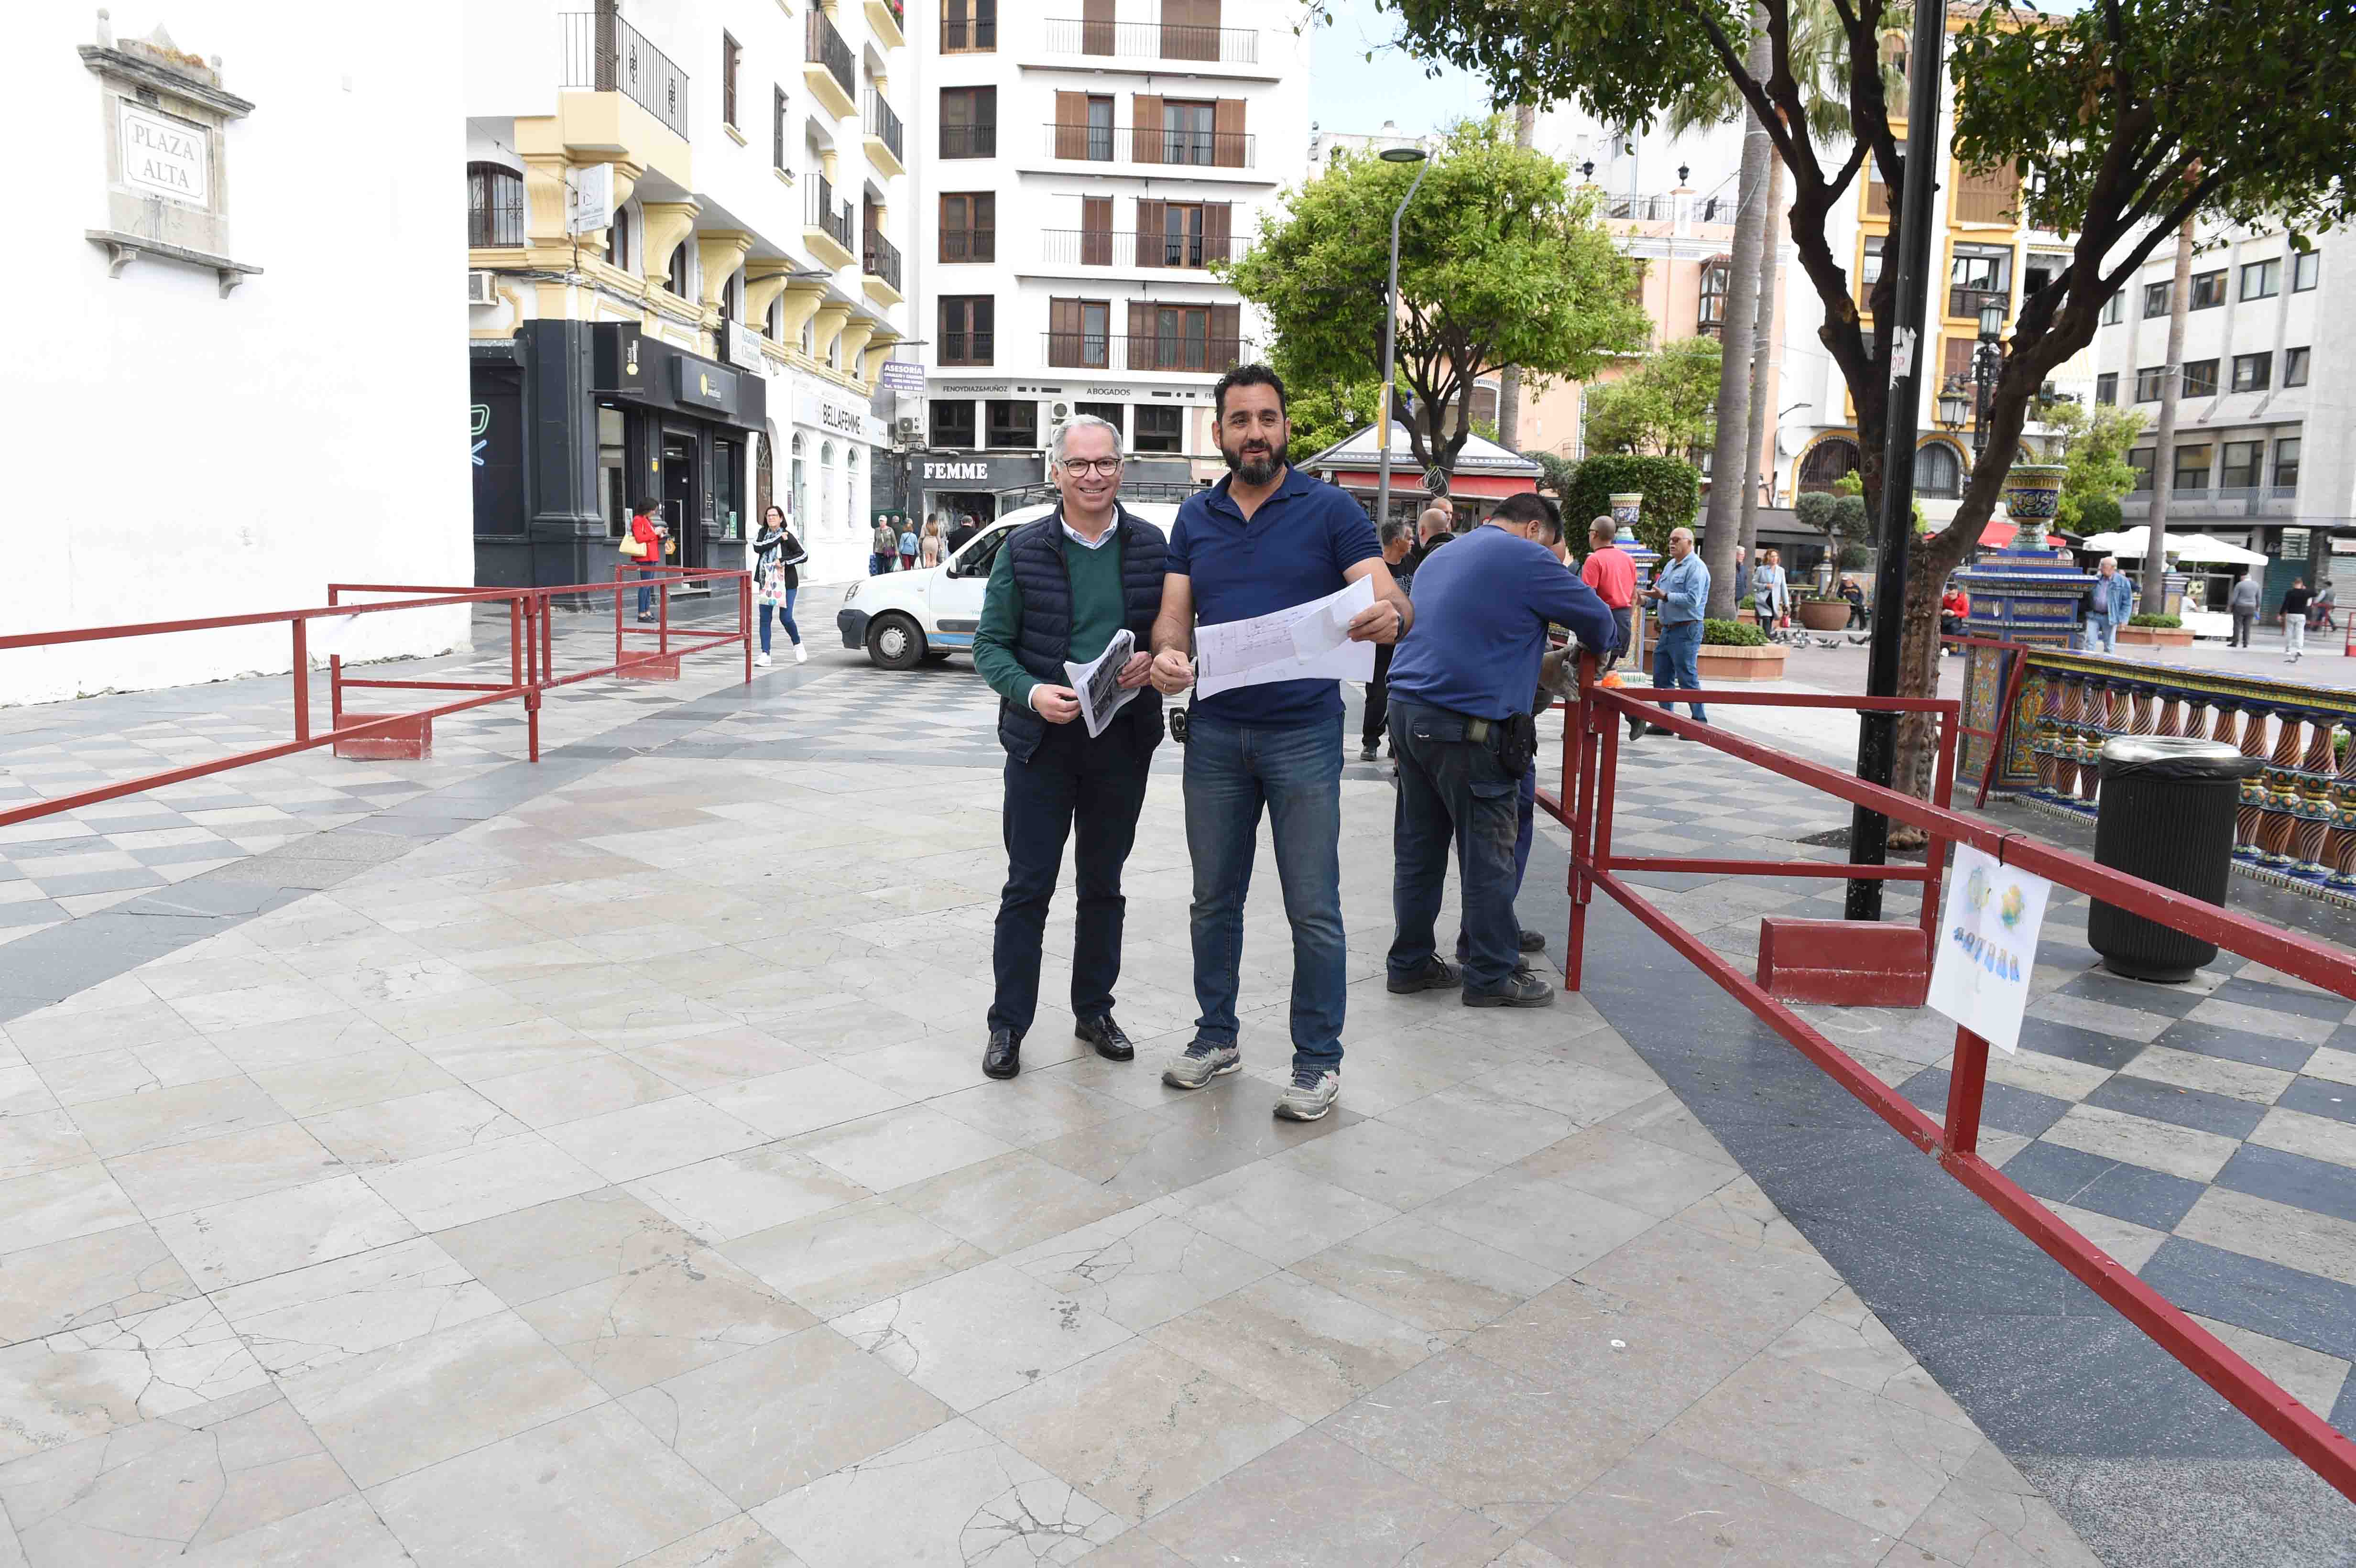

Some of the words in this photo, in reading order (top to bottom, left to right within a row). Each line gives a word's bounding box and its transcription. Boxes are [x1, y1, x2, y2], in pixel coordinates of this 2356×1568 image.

[134, 124, 194, 161] PLAZA
[143, 159, 189, 188] ALTA
[884, 364, 922, 374] ASESORÍA
[823, 403, 860, 435] BELLAFEMME
[923, 463, 988, 479] FEMME
